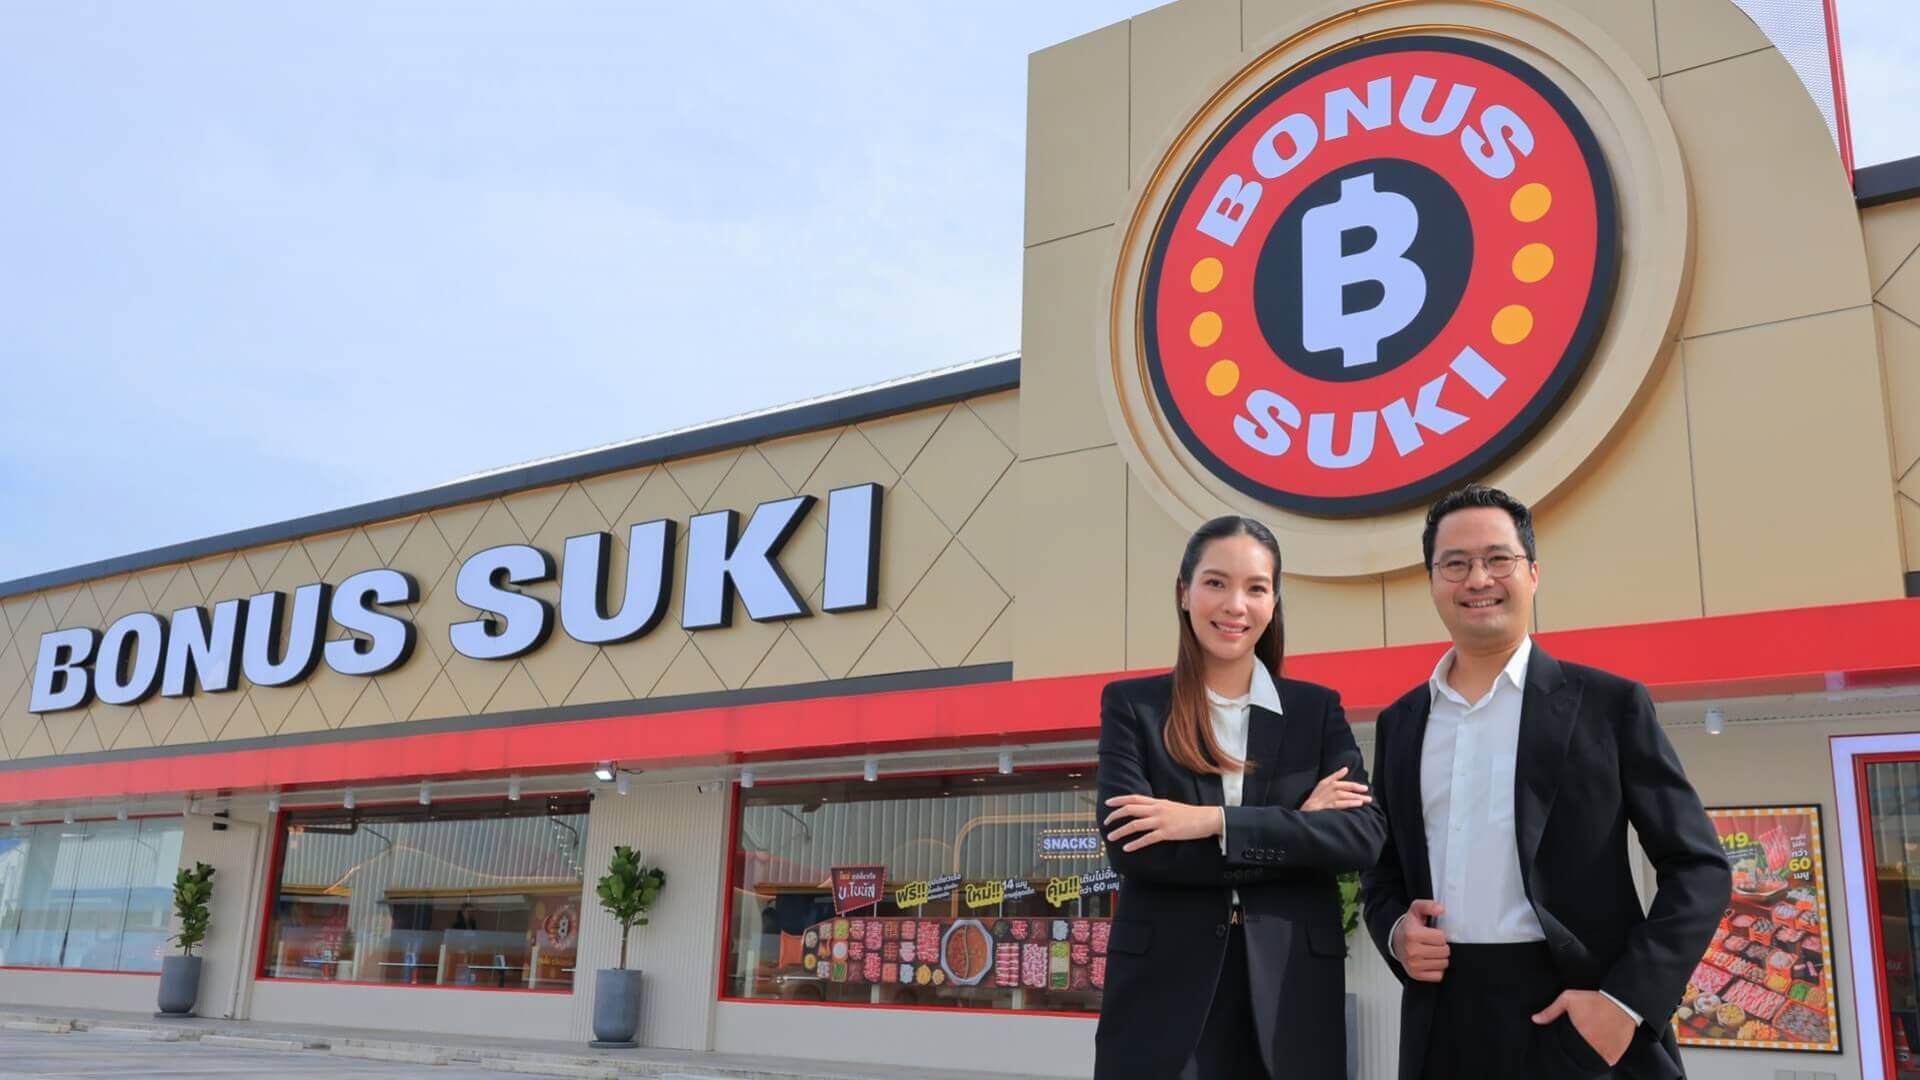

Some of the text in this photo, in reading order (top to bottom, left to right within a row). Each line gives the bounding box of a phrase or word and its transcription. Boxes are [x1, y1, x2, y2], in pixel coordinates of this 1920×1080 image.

[1196, 75, 1534, 247] BONUS
[1233, 345, 1506, 468] SUKI
[28, 483, 883, 714] BONUS SUKI
[1043, 837, 1097, 850] SNACKS
[1788, 857, 1811, 871] 60
[1093, 882, 1106, 893] 60
